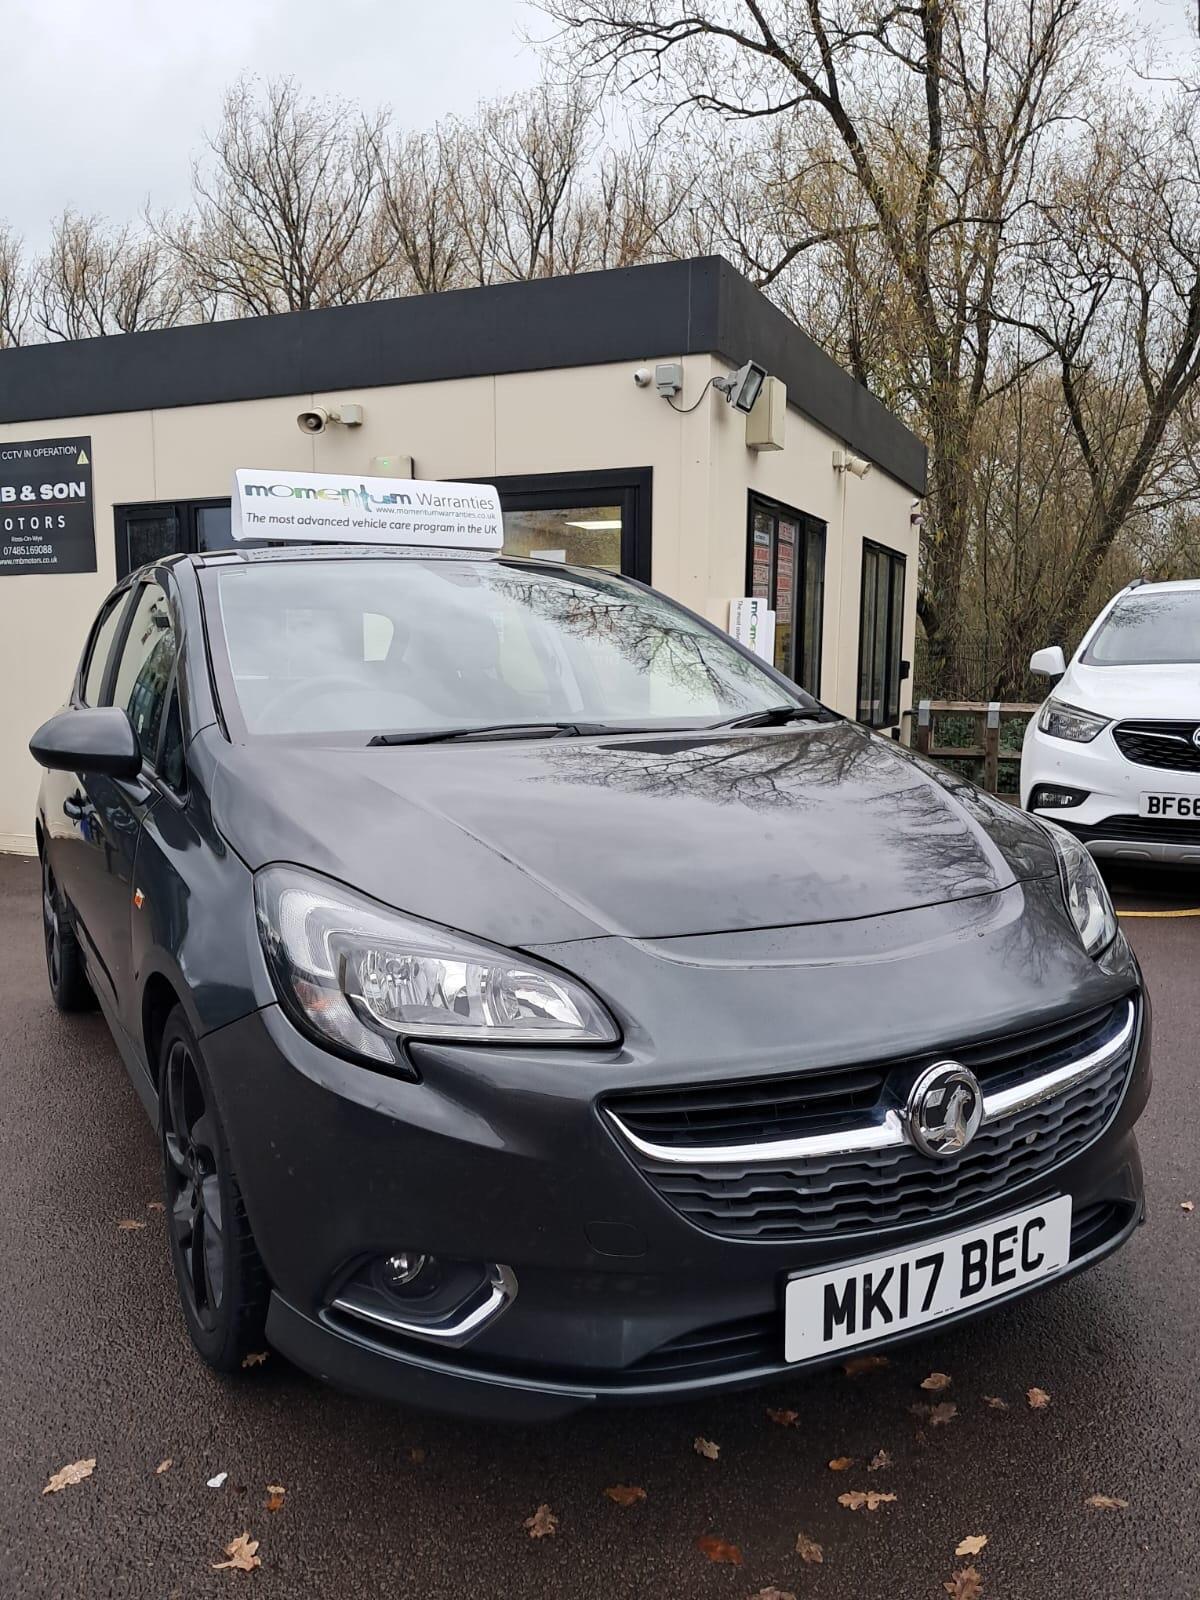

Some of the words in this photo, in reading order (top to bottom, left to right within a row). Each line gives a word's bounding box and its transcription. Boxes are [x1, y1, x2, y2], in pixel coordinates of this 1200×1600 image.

[2, 450, 23, 460] CCTV
[24, 449, 32, 458] IN
[33, 445, 77, 457] OPERATION
[1, 486, 17, 502] B
[20, 485, 36, 501] &
[40, 481, 86, 500] SON
[244, 484, 412, 513] momentum
[416, 492, 495, 510] Warranties
[4, 515, 66, 531] OTORS
[246, 512, 266, 523] The
[268, 514, 295, 525] most
[297, 515, 350, 527] advanced
[352, 517, 387, 529] vehicle
[389, 521, 411, 530] care
[413, 521, 455, 533] program
[457, 523, 465, 533] in
[467, 524, 482, 534] the
[484, 524, 498, 535] UK
[376, 507, 496, 519] www.momentumwarranties.co.uk
[823, 1252, 944, 1342] MK17
[960, 1216, 1046, 1299] BEC
